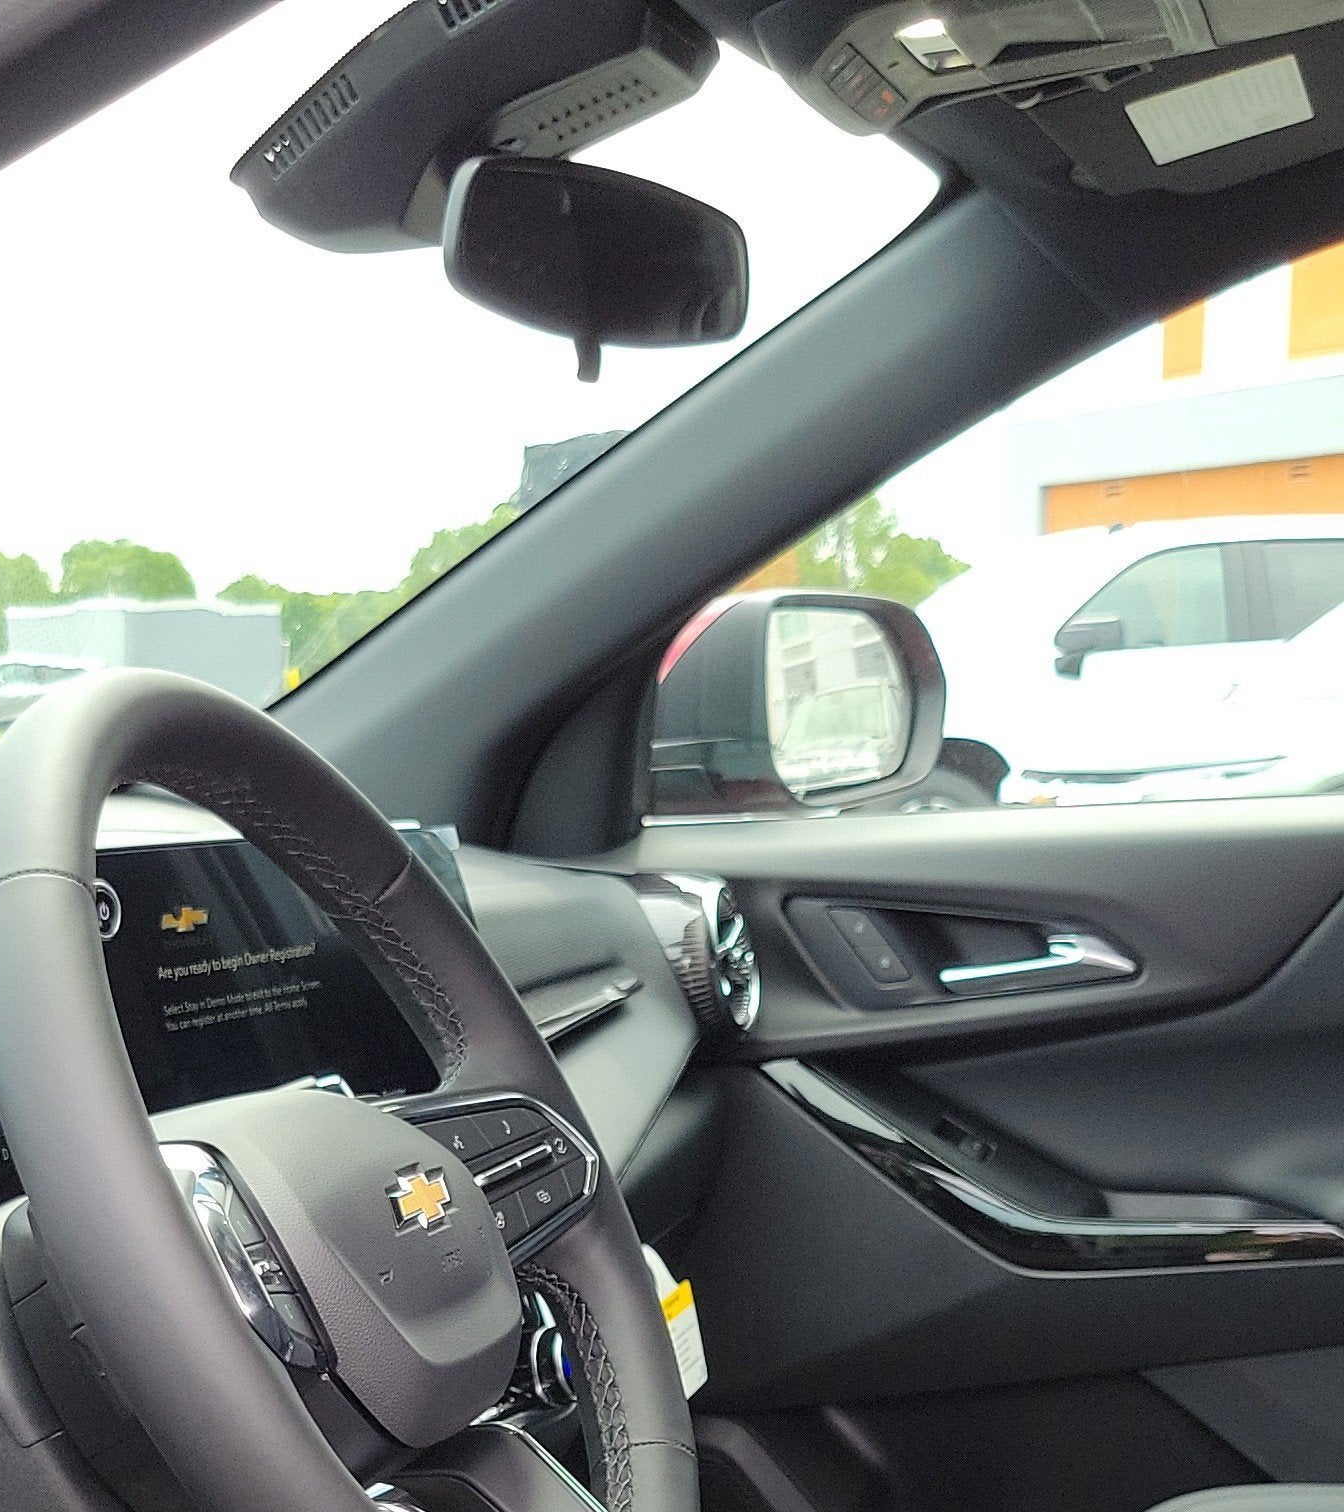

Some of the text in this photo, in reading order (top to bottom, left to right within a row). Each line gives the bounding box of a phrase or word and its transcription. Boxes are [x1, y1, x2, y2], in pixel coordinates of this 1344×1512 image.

[158, 966, 174, 981] Are
[174, 966, 189, 982] you
[189, 960, 212, 976] ready
[212, 959, 221, 971] to
[221, 955, 244, 972] begin
